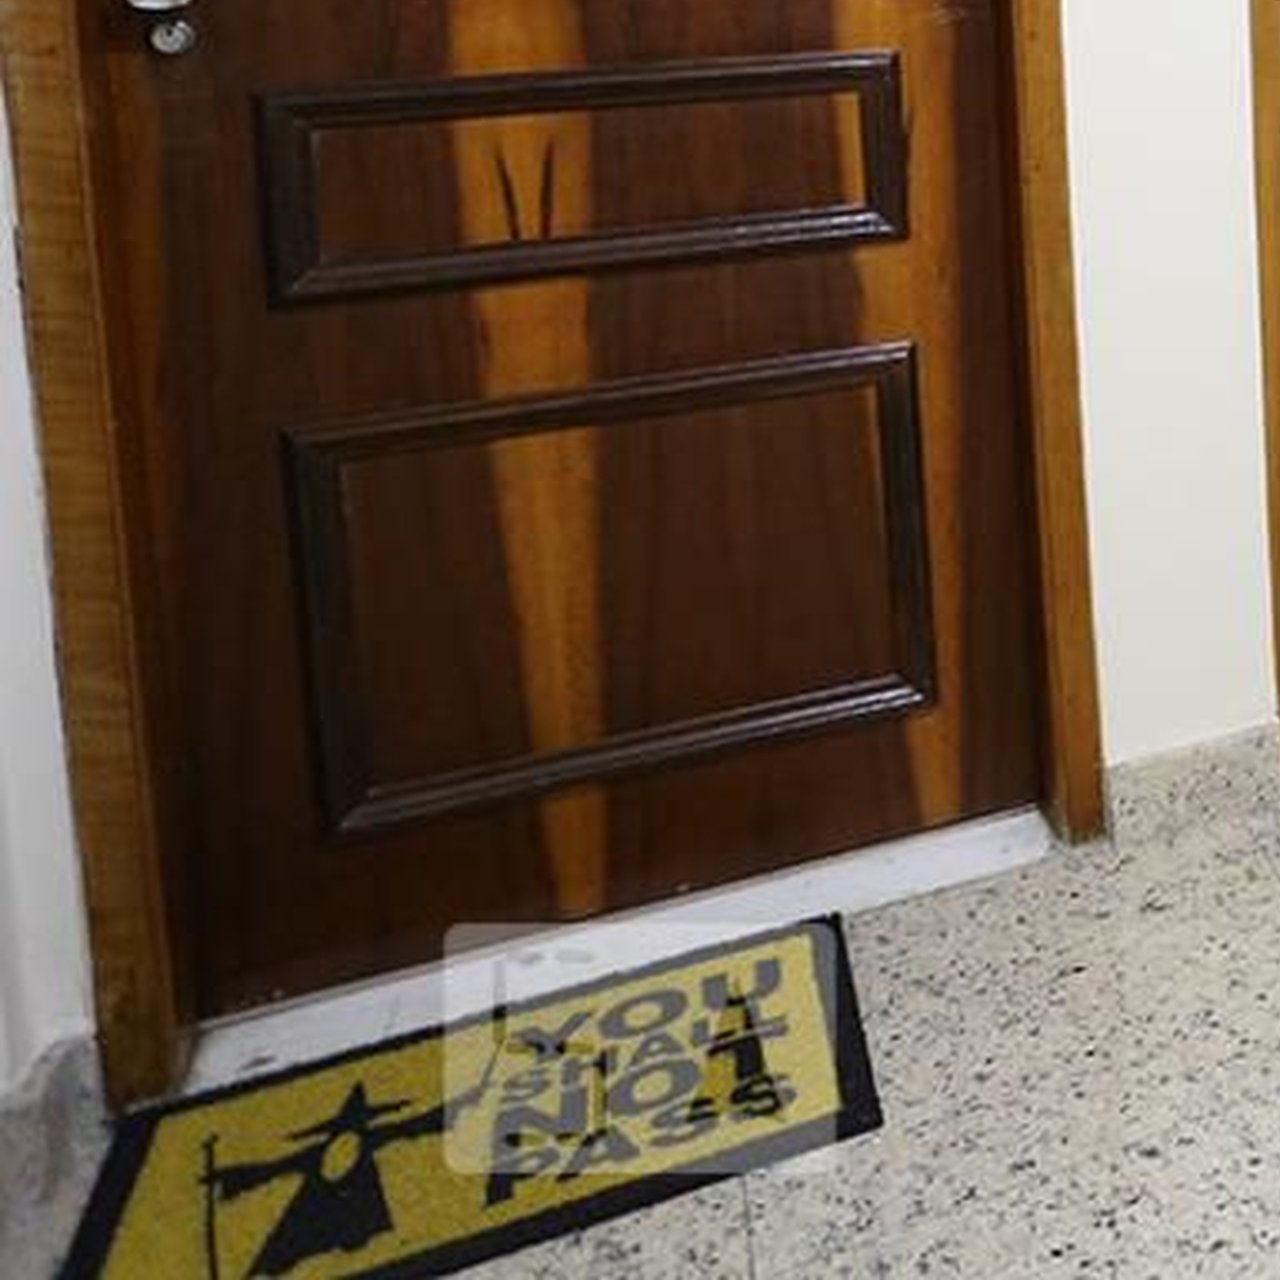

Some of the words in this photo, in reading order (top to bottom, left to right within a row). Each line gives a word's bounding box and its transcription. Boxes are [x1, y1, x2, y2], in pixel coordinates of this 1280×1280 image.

[500, 993, 788, 1104] SHALL
[507, 958, 780, 1063] YOU
[484, 1072, 797, 1204] PASS
[493, 1025, 788, 1157] NOT
